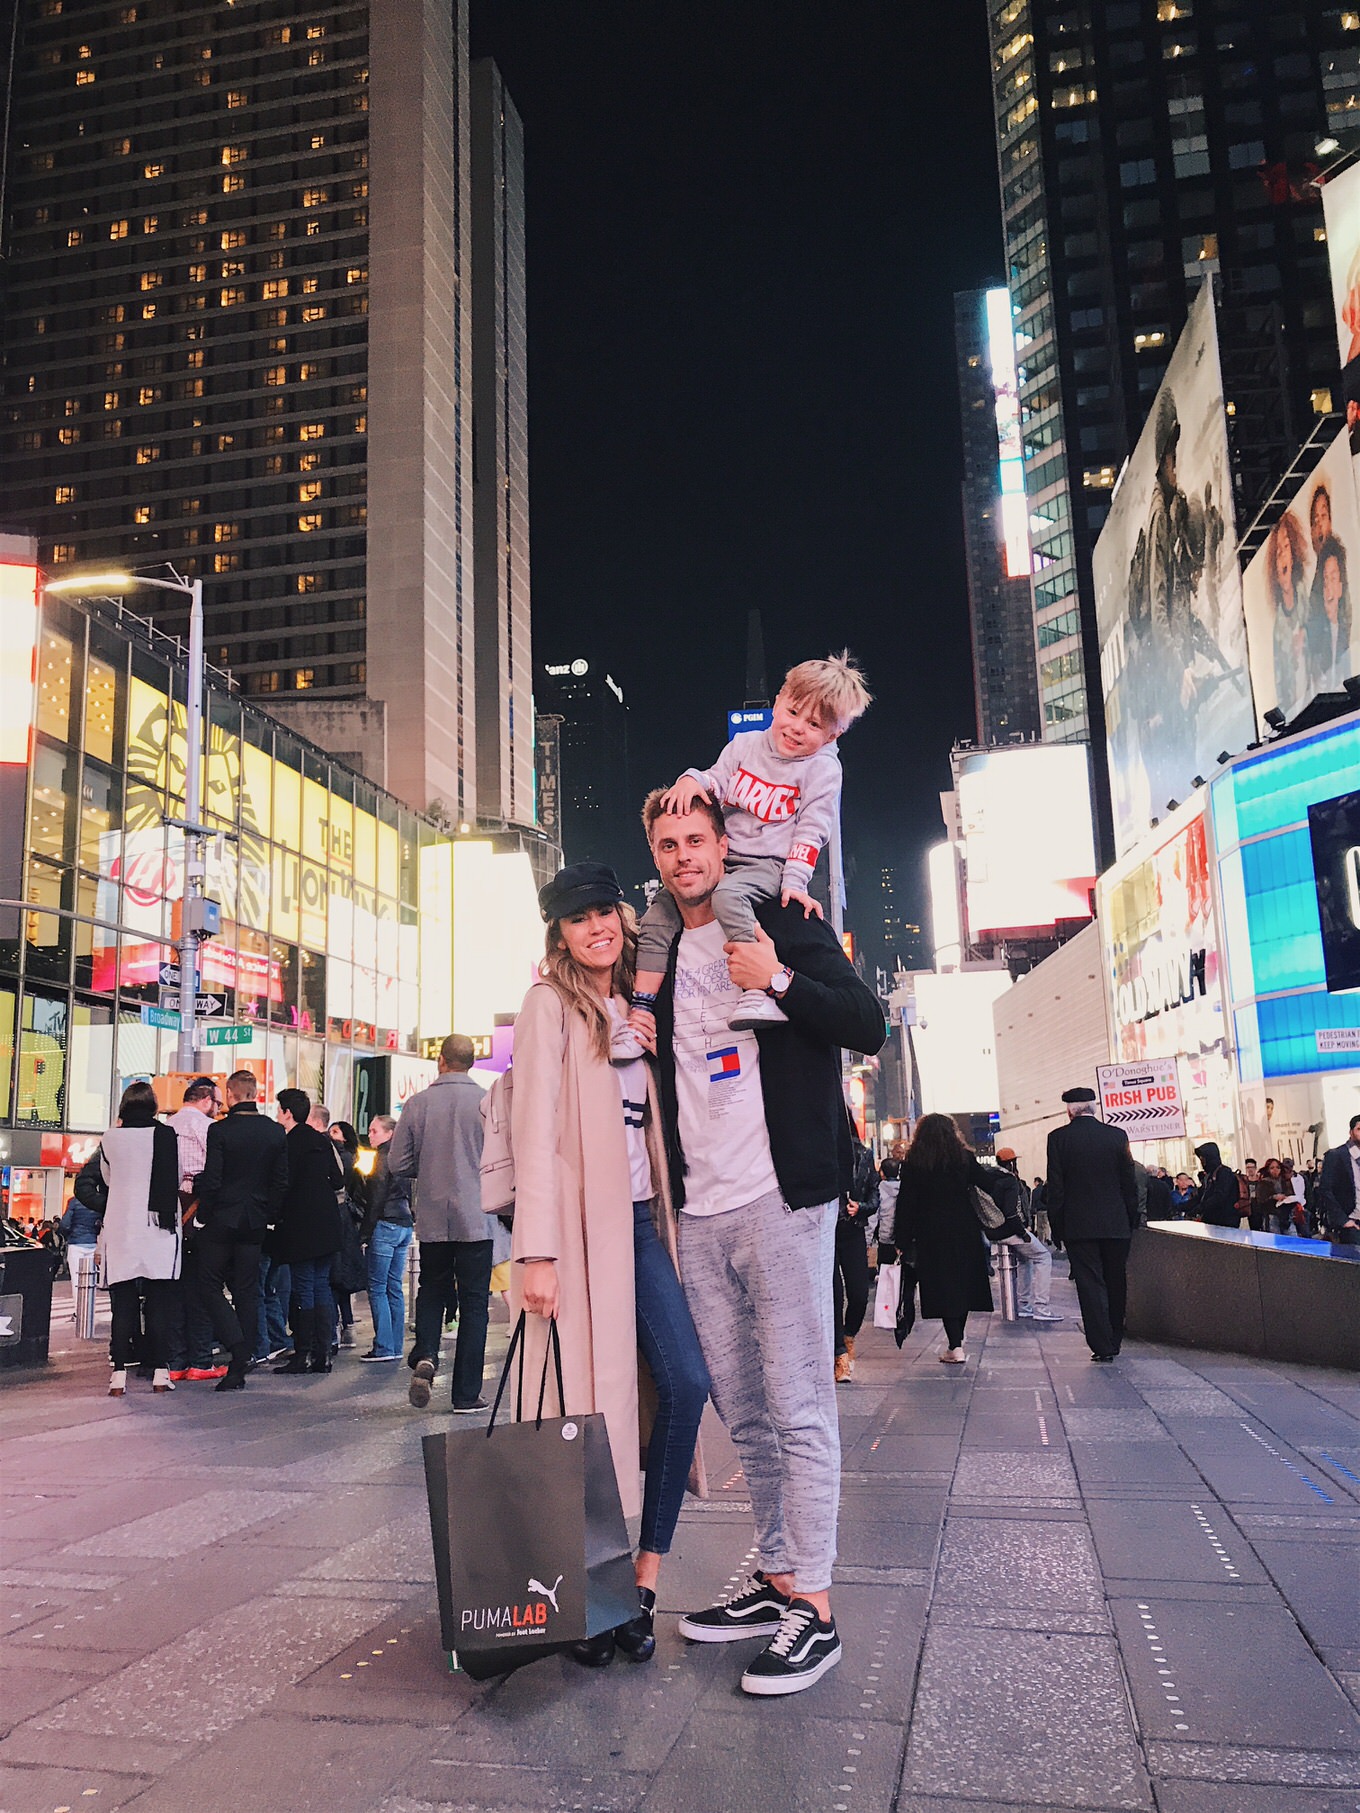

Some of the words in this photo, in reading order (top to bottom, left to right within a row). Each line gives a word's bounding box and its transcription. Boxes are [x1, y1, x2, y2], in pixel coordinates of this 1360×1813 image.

[538, 741, 557, 825] TIMES
[317, 816, 353, 860] THE
[164, 969, 178, 980] ONE
[702, 959, 726, 976] GREAT
[677, 988, 696, 999] FOR
[196, 999, 216, 1009] WAY
[150, 1009, 180, 1031] Broadway
[209, 1030, 220, 1044] W
[224, 1028, 239, 1042] 44
[243, 1027, 251, 1037] St
[1318, 1030, 1356, 1040] PEDESTRIAN
[1320, 1041, 1335, 1050] KEEP
[1101, 1061, 1173, 1079] O'Donoghue's
[1104, 1089, 1143, 1108] IRISH
[1146, 1085, 1177, 1103] PUB
[461, 1602, 547, 1632] PUMALAB
